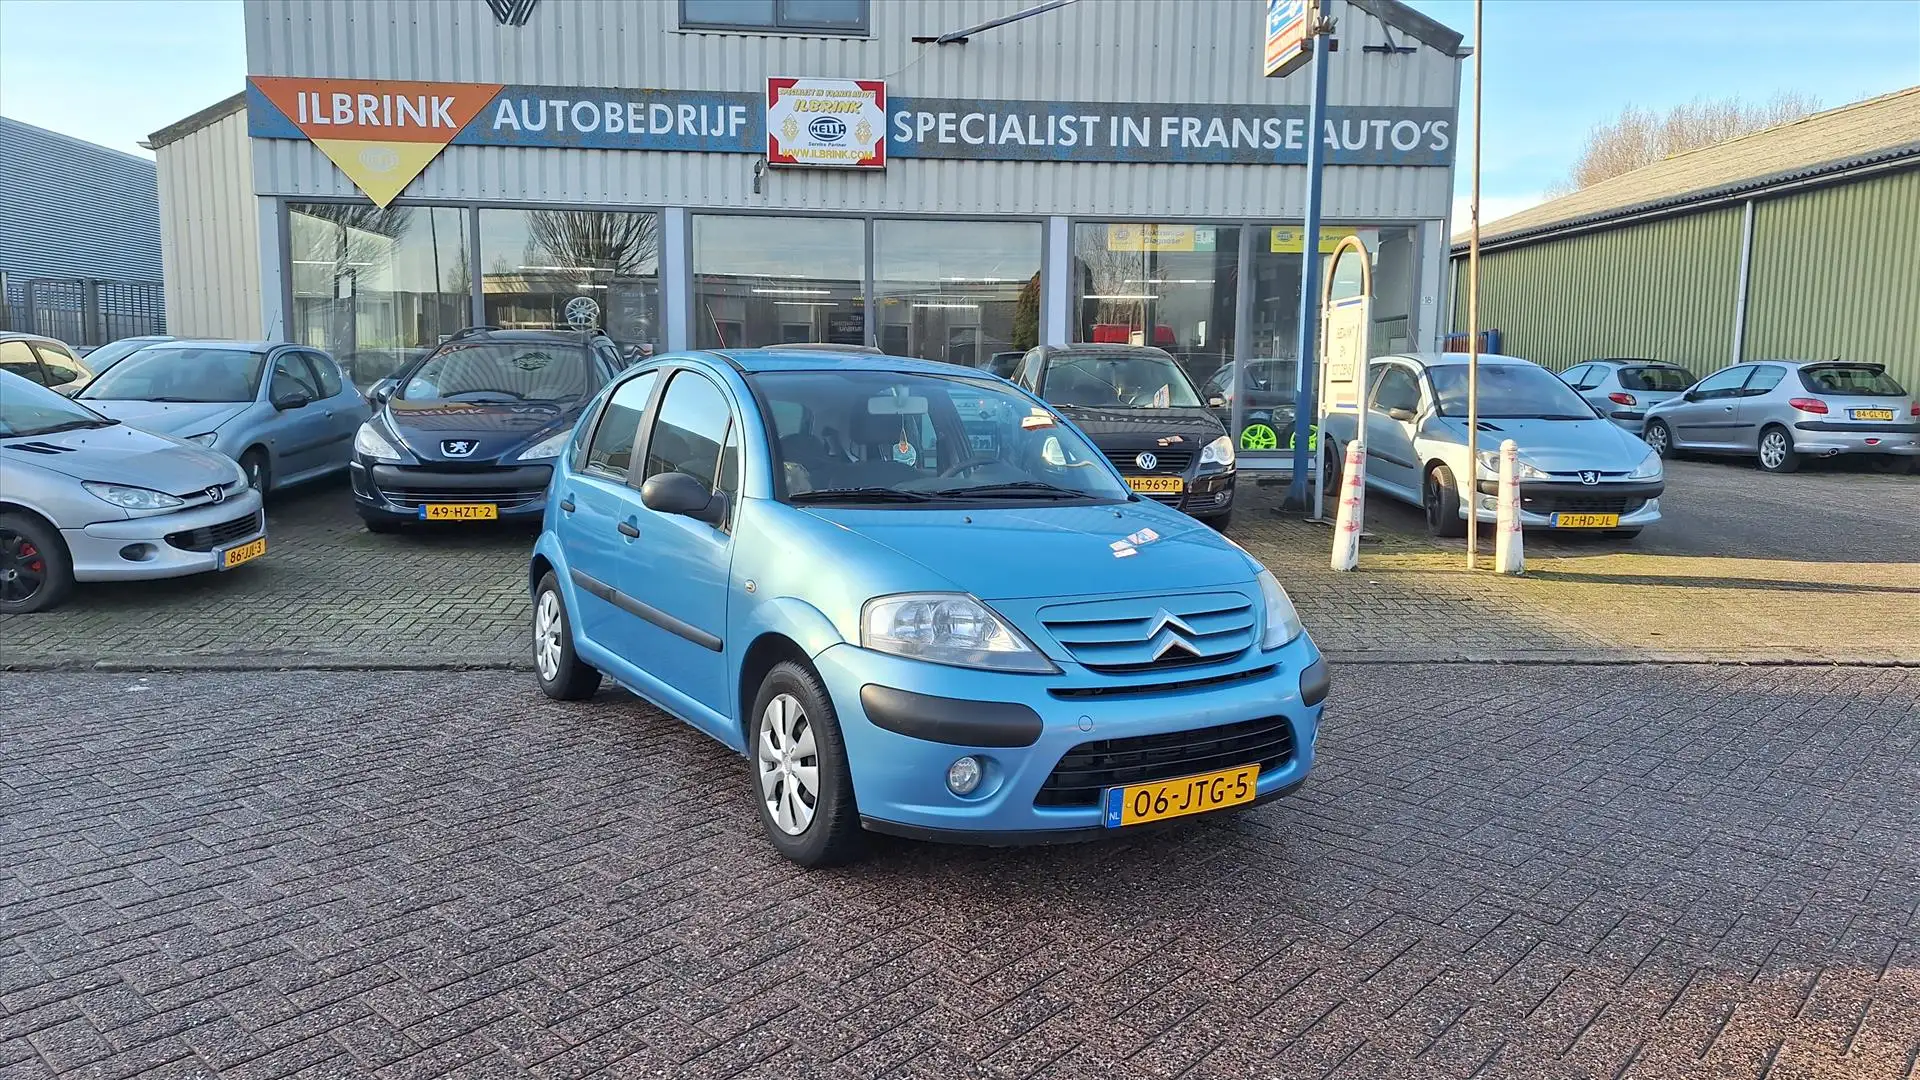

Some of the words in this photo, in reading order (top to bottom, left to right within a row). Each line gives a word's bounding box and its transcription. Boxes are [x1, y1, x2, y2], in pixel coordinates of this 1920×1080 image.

[298, 91, 458, 129] ILBRINK
[793, 99, 863, 114] ILBRINK
[493, 98, 747, 137] AUTOBEDRIJF
[811, 123, 847, 134] HELLA
[893, 110, 1100, 147] SPECIALIST
[1110, 116, 1151, 148] IN
[1160, 116, 1305, 150] FRANSE
[1323, 119, 1449, 151] AUTO'S
[782, 148, 873, 160] WWW.ILBRINK.COM
[1856, 410, 1890, 418] 84-GL-TG
[431, 506, 492, 518] 49-HZT-2
[1562, 515, 1612, 526] 21-HD-JL
[230, 541, 262, 563] 86-JJL-3
[1133, 772, 1249, 817] 06-JTG-5
[1109, 812, 1120, 821] NL
